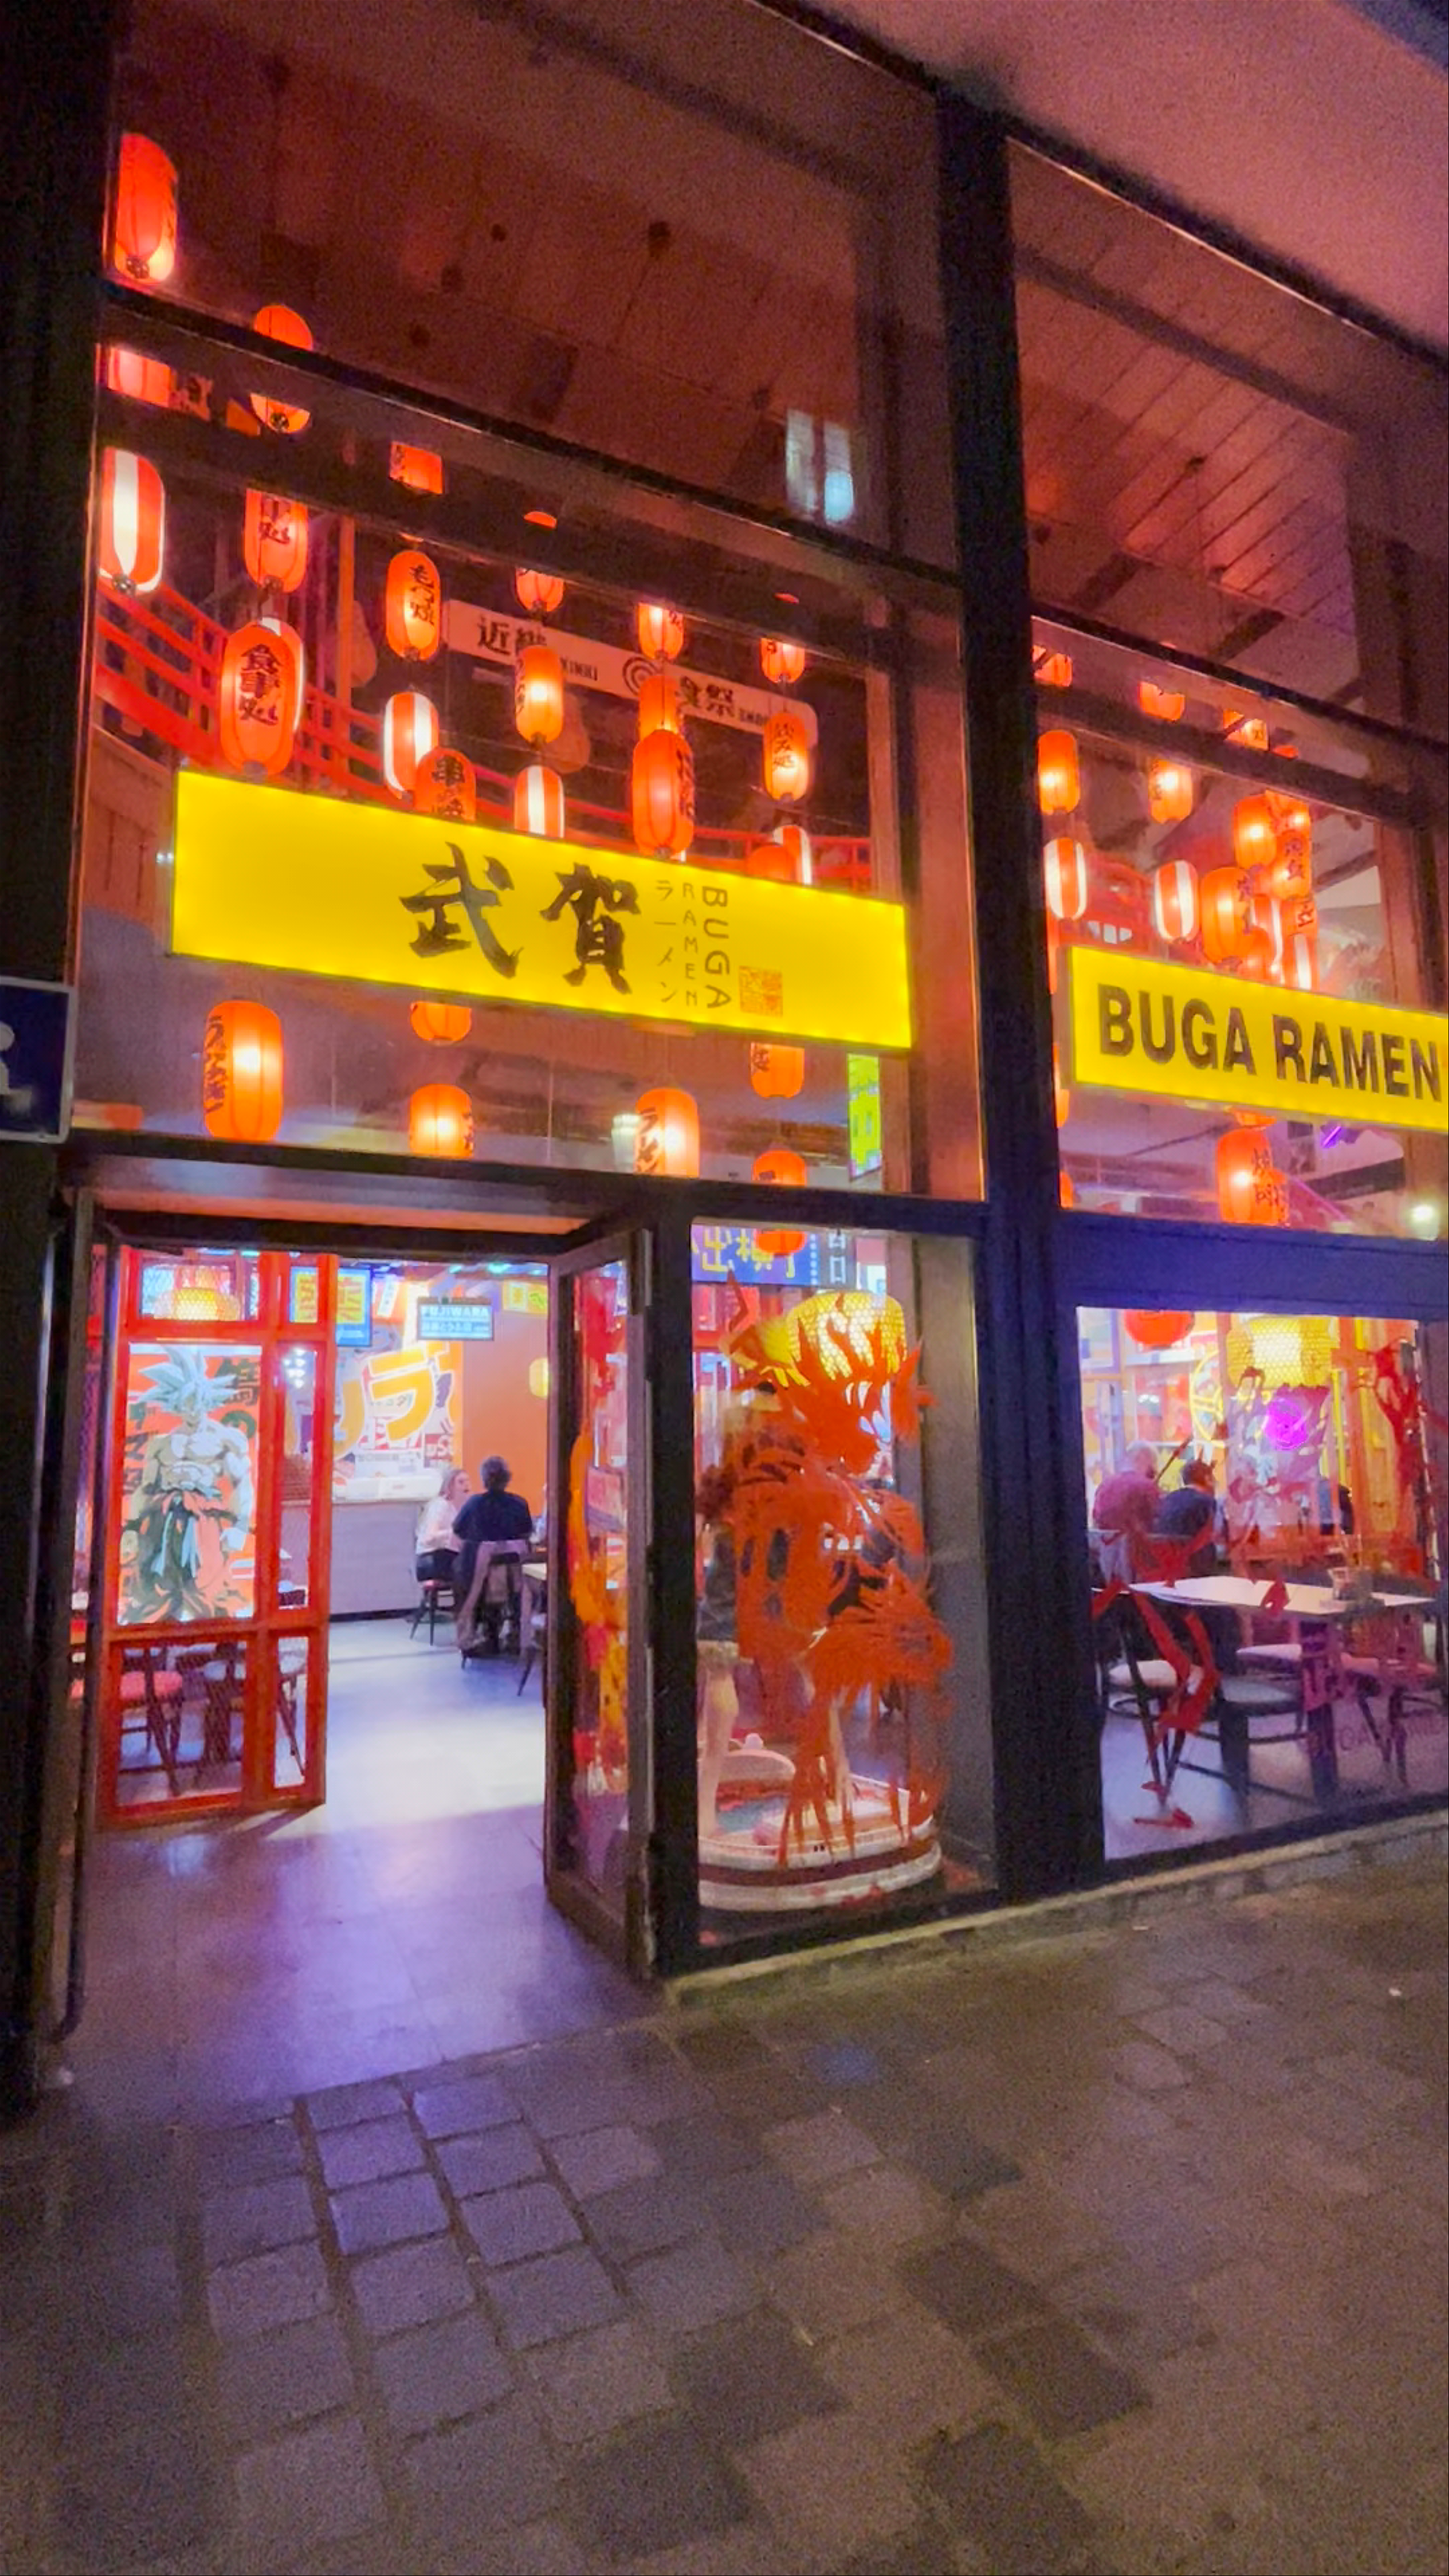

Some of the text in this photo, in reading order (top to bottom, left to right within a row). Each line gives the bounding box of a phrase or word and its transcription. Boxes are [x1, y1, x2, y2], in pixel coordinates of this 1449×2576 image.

[654, 879, 677, 1003] ラーメン
[682, 882, 702, 1007] RAMEN
[702, 885, 732, 1009] BUGA
[1097, 983, 1442, 1103] BUGA RAMEN
